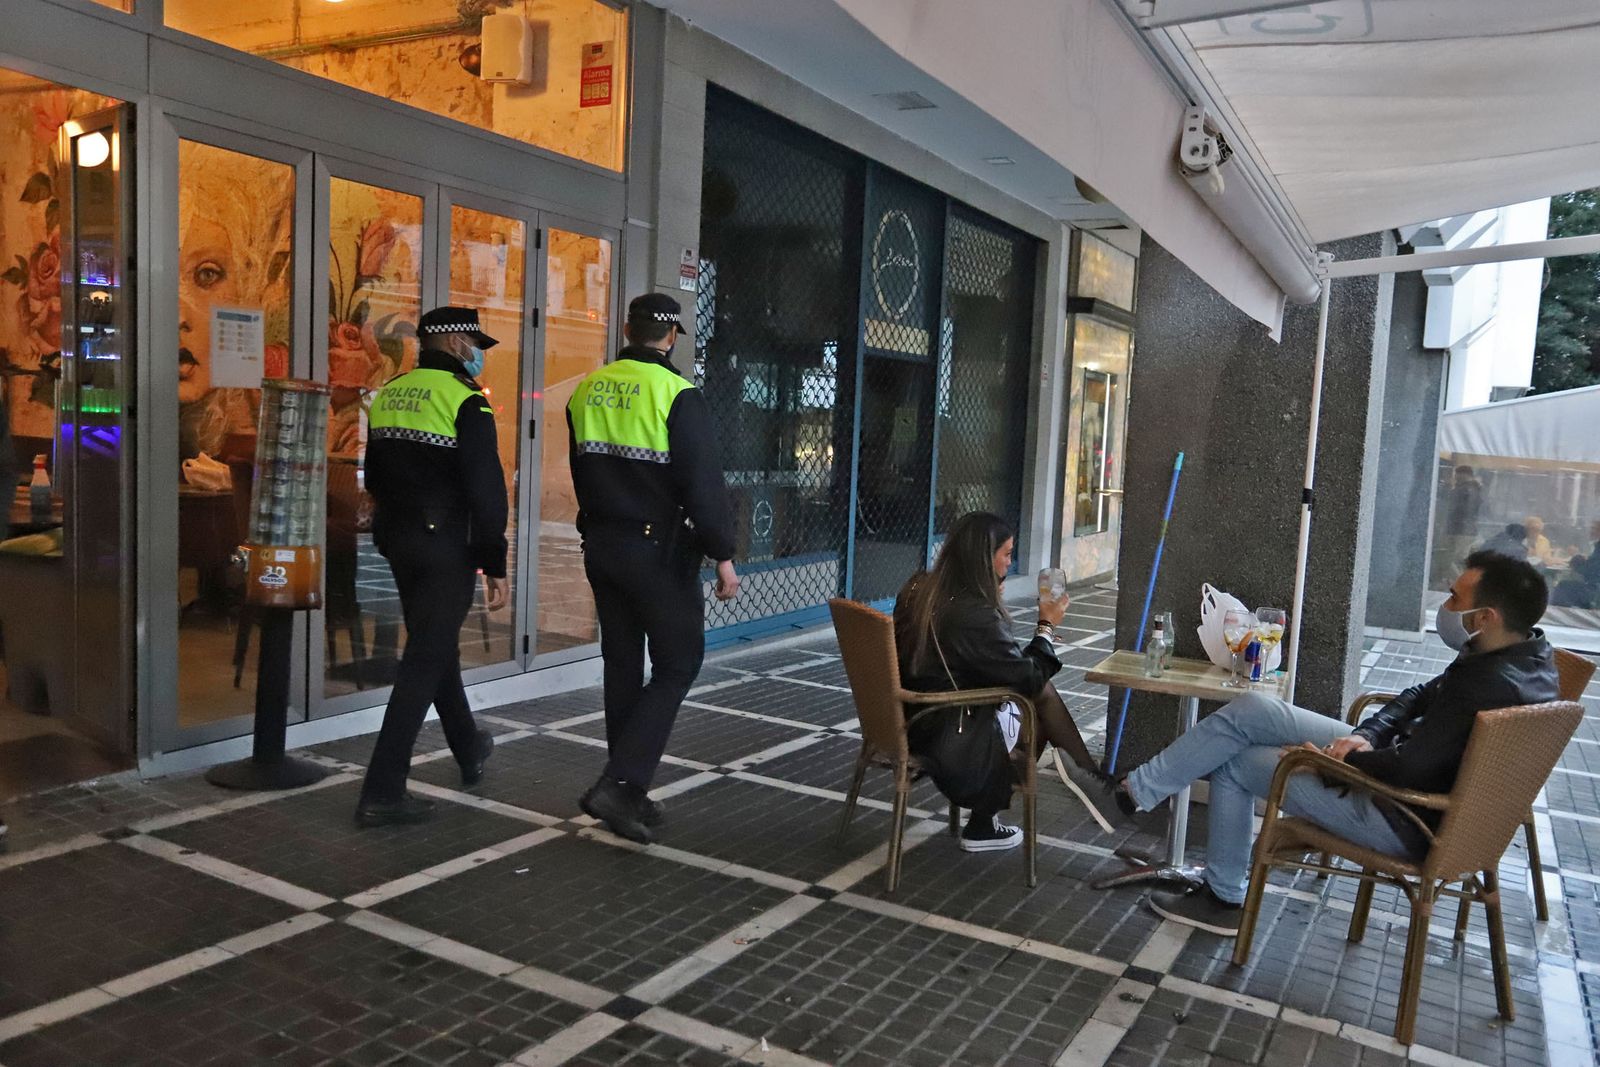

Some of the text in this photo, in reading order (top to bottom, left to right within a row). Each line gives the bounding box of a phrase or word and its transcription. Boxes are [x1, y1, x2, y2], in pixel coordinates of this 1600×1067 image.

[583, 69, 610, 80] Alarma
[381, 386, 432, 401] POLICIA
[587, 380, 640, 396] POLICIA
[381, 399, 422, 413] LOCAL
[587, 394, 631, 410] LOCAL
